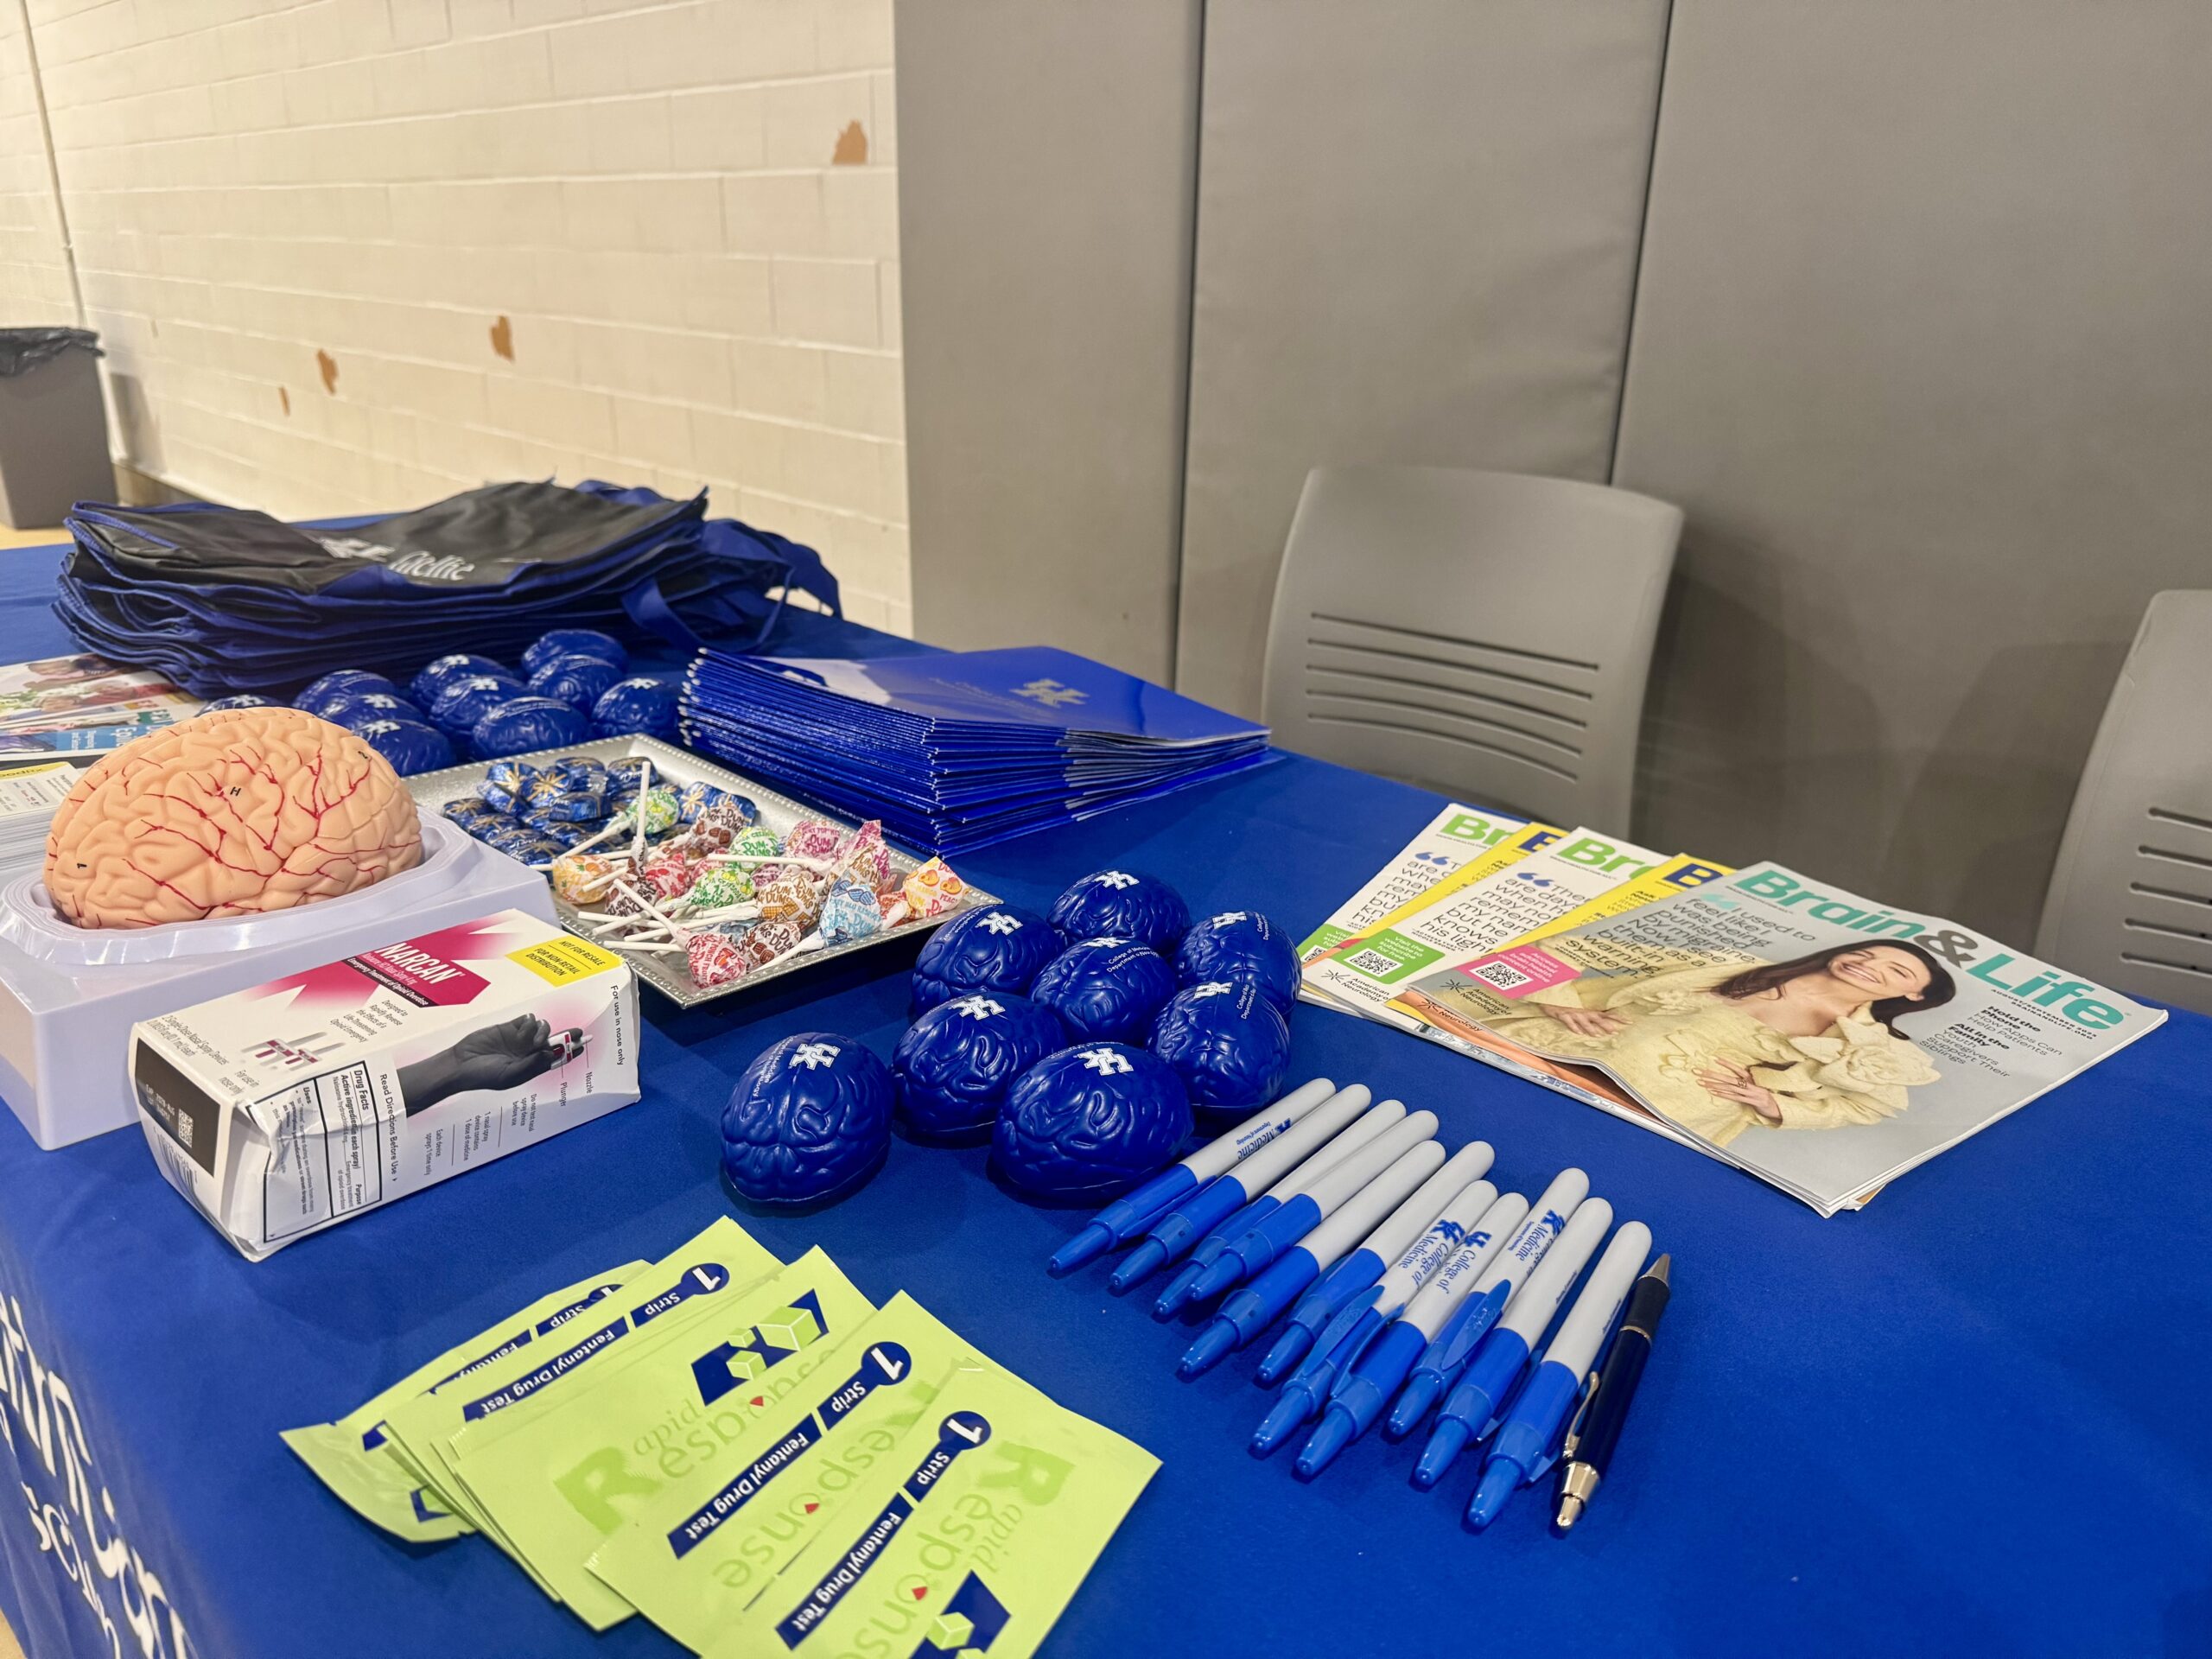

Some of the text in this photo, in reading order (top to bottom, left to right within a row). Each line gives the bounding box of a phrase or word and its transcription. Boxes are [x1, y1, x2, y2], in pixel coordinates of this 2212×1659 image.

[230, 786, 241, 797] H
[1406, 860, 1439, 875] are
[1376, 890, 1409, 904] my
[1495, 884, 1549, 909] when
[1504, 878, 1536, 894] are
[1458, 901, 1491, 918] my
[1481, 890, 1528, 911] may
[1446, 907, 1508, 938] but he
[1673, 904, 1775, 948] was being
[1686, 898, 1726, 918] feel
[1725, 915, 1759, 932] like
[1740, 909, 1795, 934] used
[1792, 930, 1817, 942] to
[1420, 920, 1450, 938] his
[1433, 913, 1499, 945] knows
[1627, 918, 1675, 945] Now,
[1686, 947, 1727, 963] see
[1642, 913, 1756, 964] by migraine.
[1654, 910, 1753, 950] punished
[560, 941, 606, 966] NOT FOR RESALE
[1379, 942, 1417, 960] subscribe
[1384, 938, 1415, 954] website
[1394, 936, 1425, 953] Visit the
[1582, 934, 1662, 978] warning
[1597, 929, 1664, 963] built-in
[1612, 924, 1666, 952] them
[1664, 949, 1692, 962] as
[525, 954, 567, 976] DISTRIBUTION
[533, 948, 581, 975] FOR NON-RETAIL
[1108, 951, 1127, 964] College
[1565, 938, 1639, 979] system.
[1340, 982, 1383, 1003] Neurology
[1346, 980, 1384, 1001] Academy
[1352, 977, 1390, 996] American
[1472, 988, 1510, 1010] American
[1459, 993, 1502, 1016] Neurology
[1466, 991, 1504, 1014] Academy
[1991, 988, 2098, 1038] AUGUST/SEPTEMBER 2025
[615, 1017, 621, 1027] in
[1439, 1010, 1483, 1033] Neurology
[1980, 1009, 2022, 1031] Phone
[1987, 1005, 2042, 1032] Hold the
[2011, 1001, 2094, 1040] BRAINANDLIFE.ORG
[1942, 1029, 1978, 1048] Youth
[1947, 1025, 1993, 1047] Family
[1954, 1022, 2011, 1050] All in the
[1967, 1015, 2048, 1057] Help Patients
[1974, 1012, 2063, 1056] How Apps Can
[1918, 1040, 1967, 1065] Siblings
[1926, 1036, 2012, 1078] Support Their
[1934, 1033, 1999, 1065] Caregivers
[303, 1086, 312, 1104] Uses
[340, 1074, 351, 1096] Active
[353, 1070, 369, 1110] Drug Facts
[380, 1074, 391, 1096] Read
[584, 1071, 593, 1094] Nozzle
[385, 1096, 396, 1137] Directions
[390, 1135, 398, 1162] Before
[1397, 1233, 1439, 1268] Medicine
[1515, 1224, 1548, 1262] Medicine
[1436, 1249, 1477, 1294] College of
[480, 1267, 722, 1414] 1 Strip Fentanyl Drug Test
[685, 1347, 904, 1541] 1 Strip Fentanyl Drug Test
[791, 1417, 982, 1633] 1 Strip Fentanyl Drug Test
